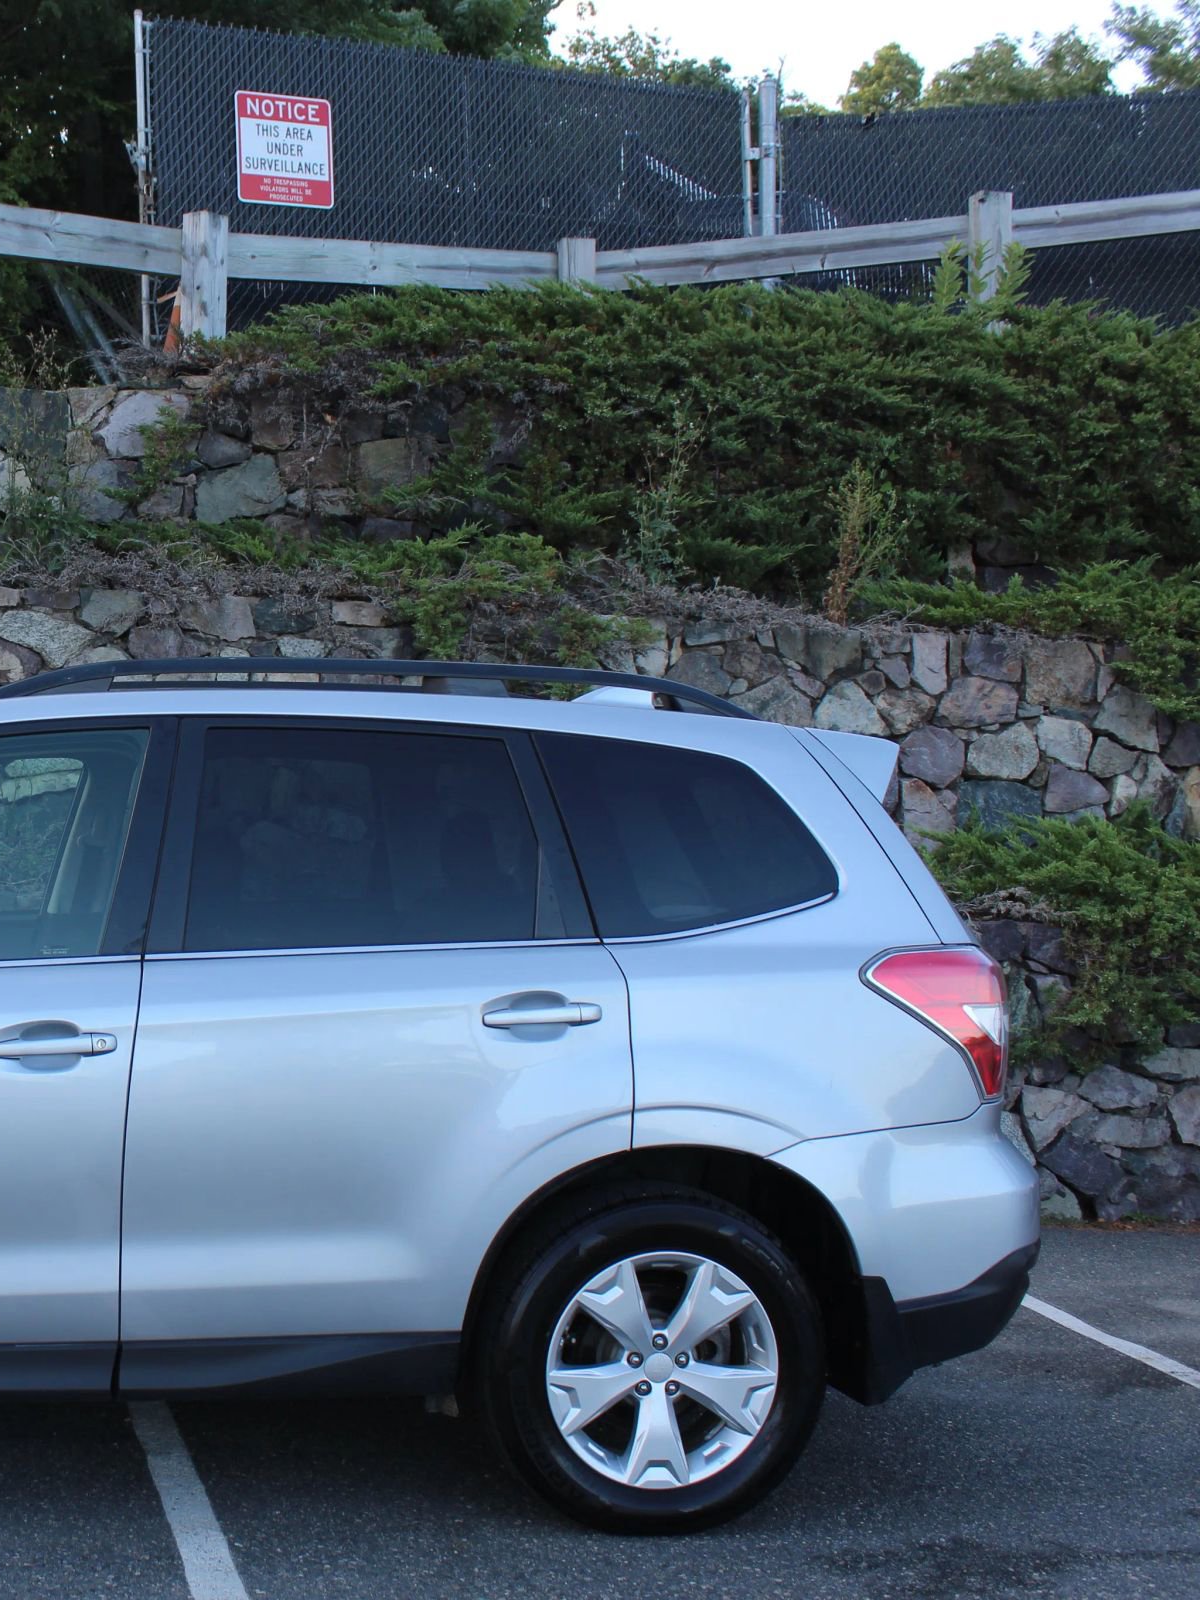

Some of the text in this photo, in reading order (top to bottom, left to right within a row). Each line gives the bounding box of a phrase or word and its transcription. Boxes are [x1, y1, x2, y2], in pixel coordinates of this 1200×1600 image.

[246, 97, 320, 122] NOTICE
[256, 123, 313, 141] THIS AREA
[266, 142, 304, 157] UNDER
[245, 156, 326, 176] SURVEILLANCE
[260, 185, 289, 193] VIOLATORS
[273, 178, 309, 187] TRESPASSING
[269, 193, 304, 202] PROSECUTED
